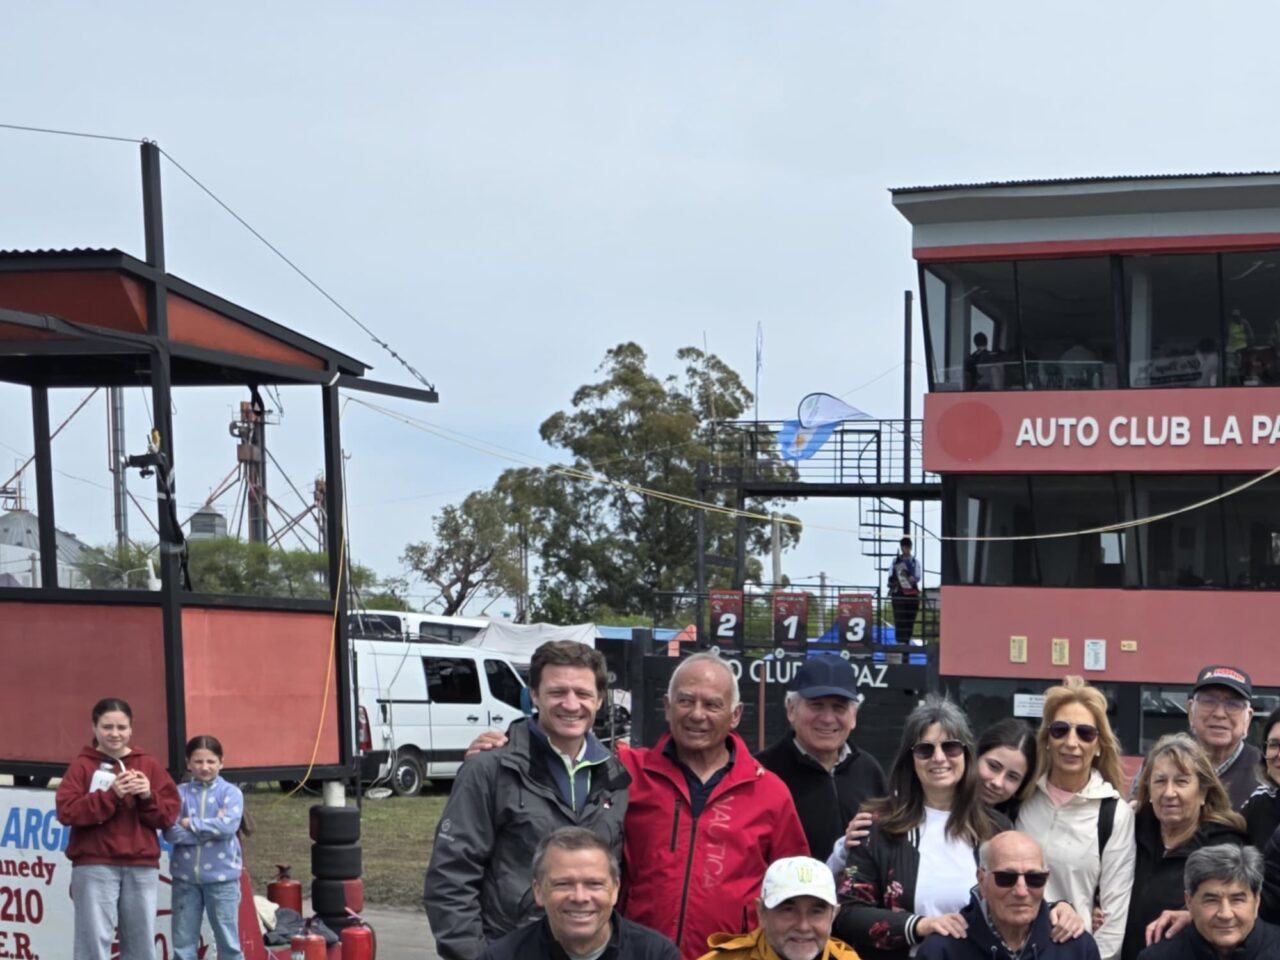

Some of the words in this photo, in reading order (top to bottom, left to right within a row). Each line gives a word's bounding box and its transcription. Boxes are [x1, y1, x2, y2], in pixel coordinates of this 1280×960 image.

[1016, 416, 1099, 447] AUTO
[1108, 416, 1191, 447] CLUB
[1203, 416, 1243, 446] LA
[717, 613, 737, 637] 2
[783, 615, 799, 639] 1
[846, 617, 866, 641] 3
